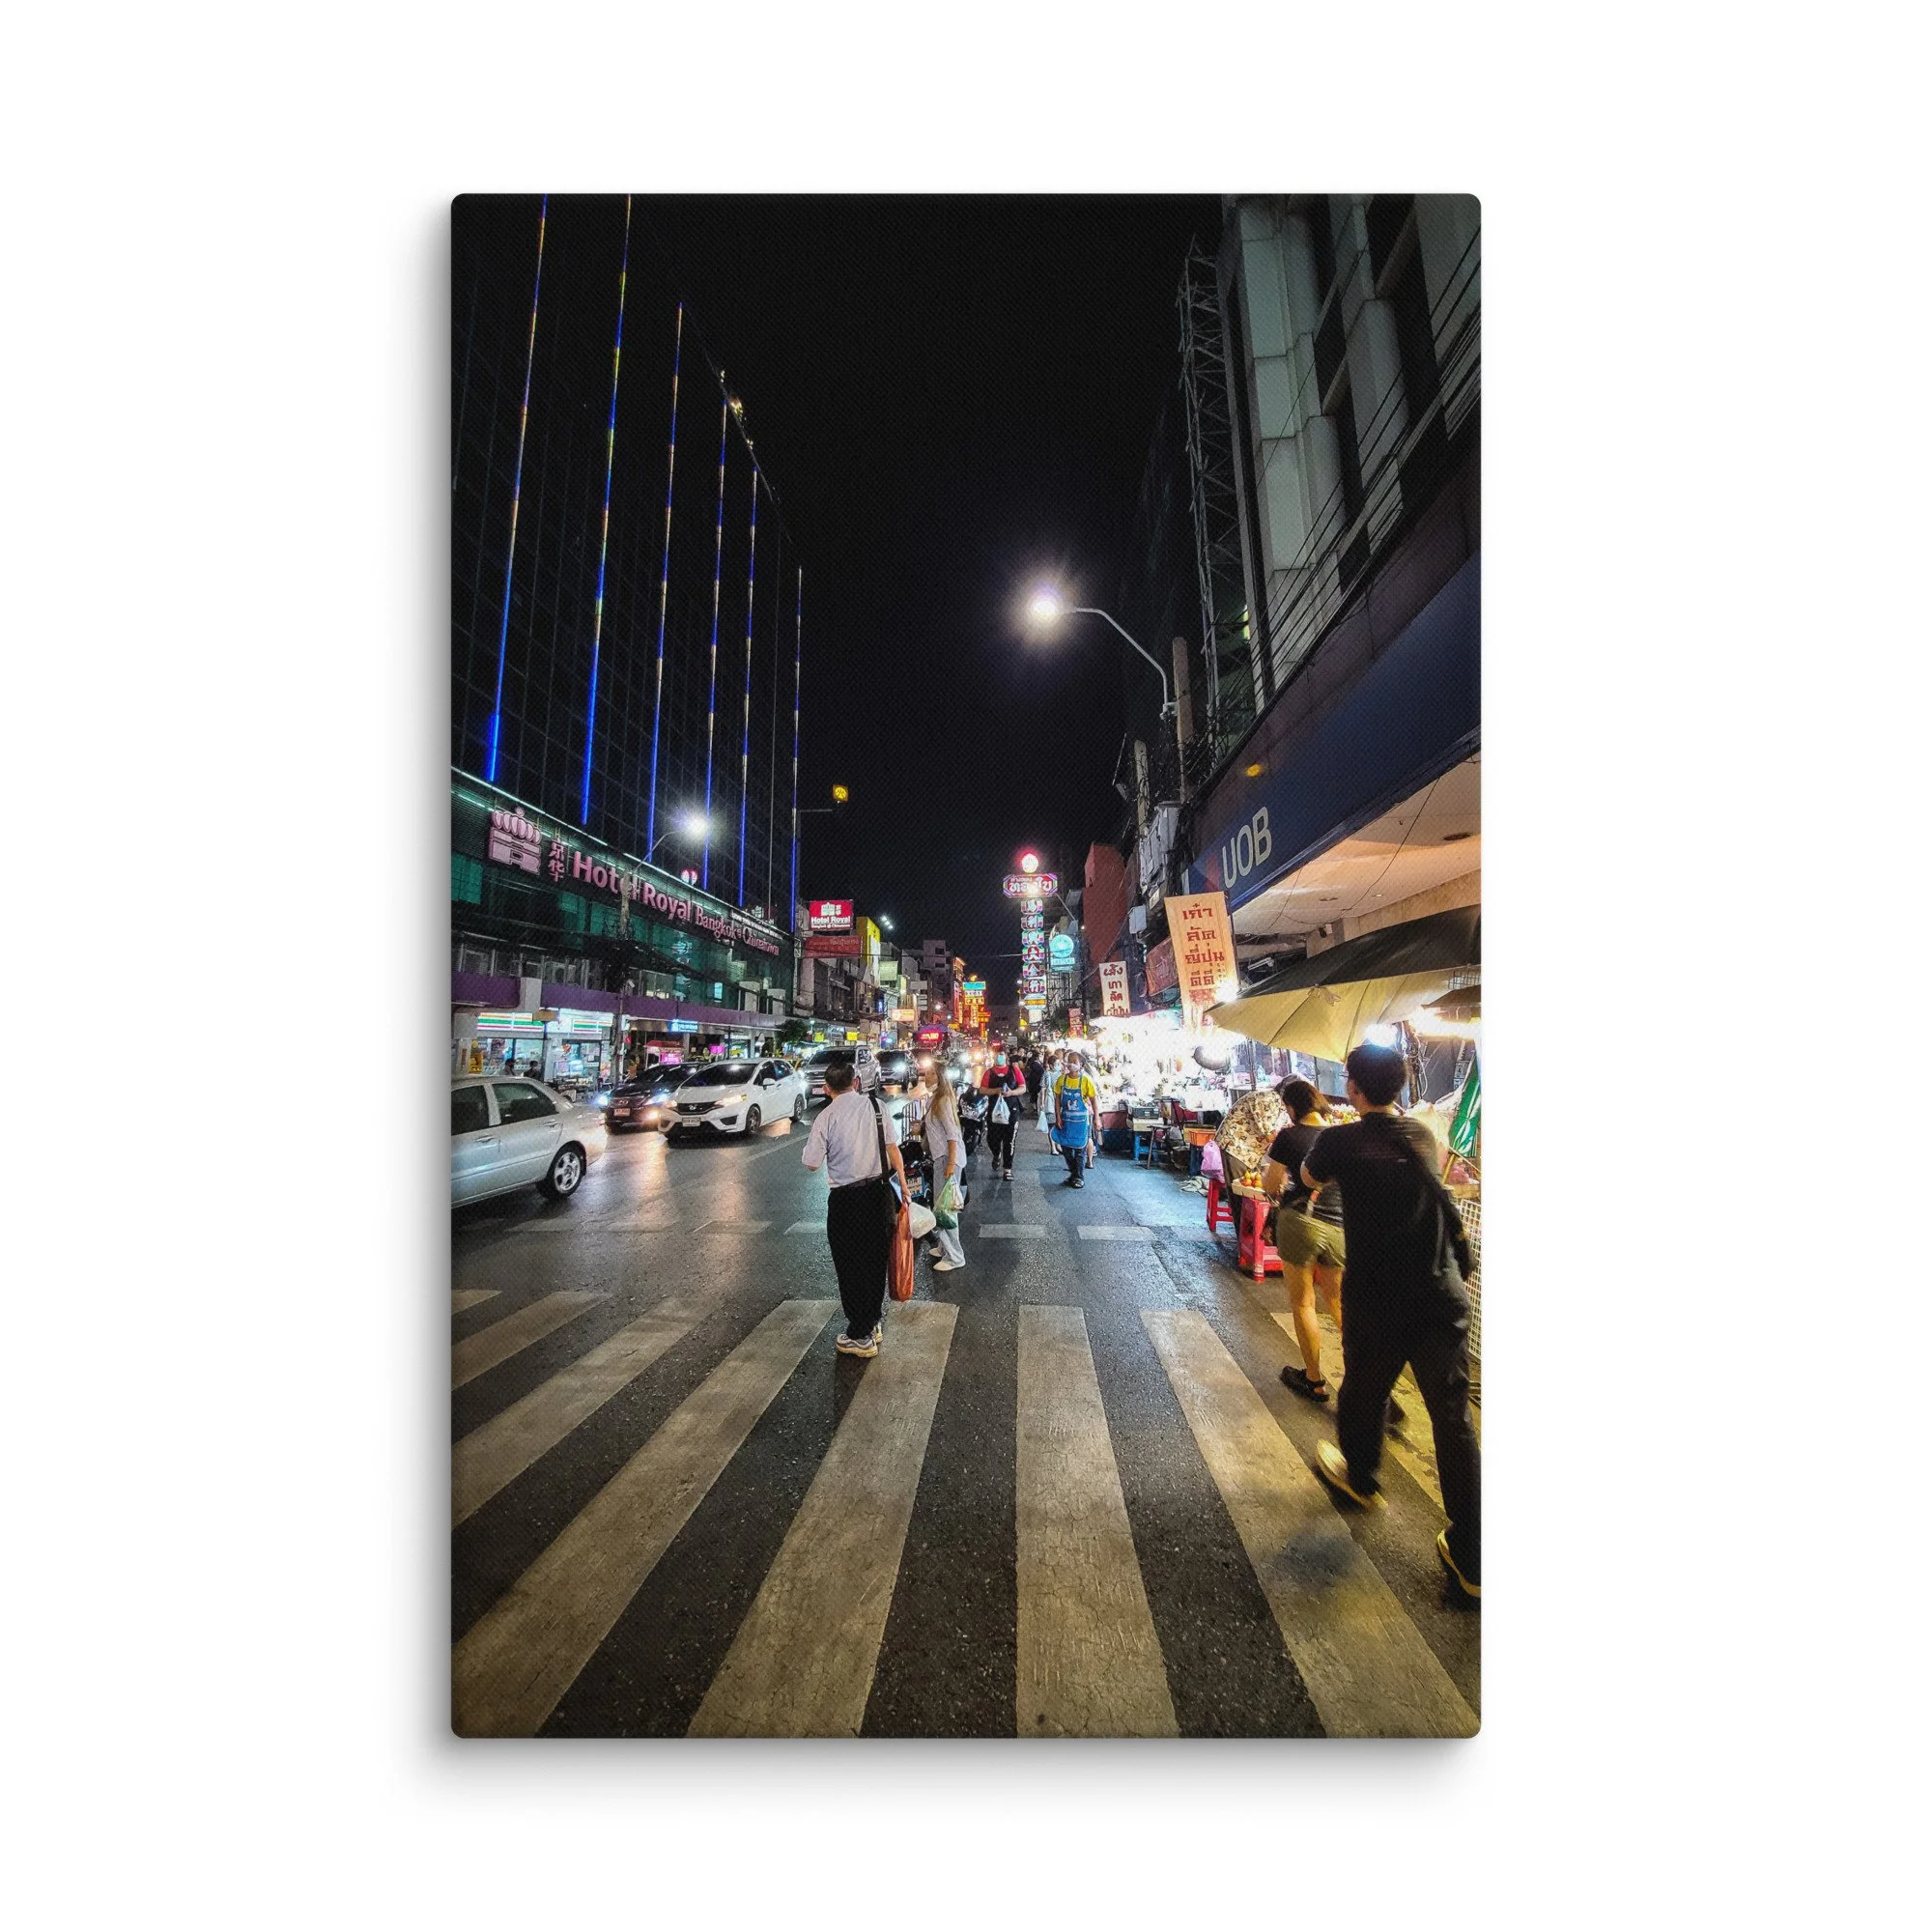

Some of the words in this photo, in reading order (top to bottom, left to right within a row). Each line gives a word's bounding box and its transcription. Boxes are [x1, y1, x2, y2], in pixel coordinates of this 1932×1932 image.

[1222, 806, 1272, 888] UOB
[642, 881, 692, 921] Royal
[695, 905, 737, 940] Bangkok
[810, 916, 830, 924] Hotel
[831, 915, 851, 924] Royal
